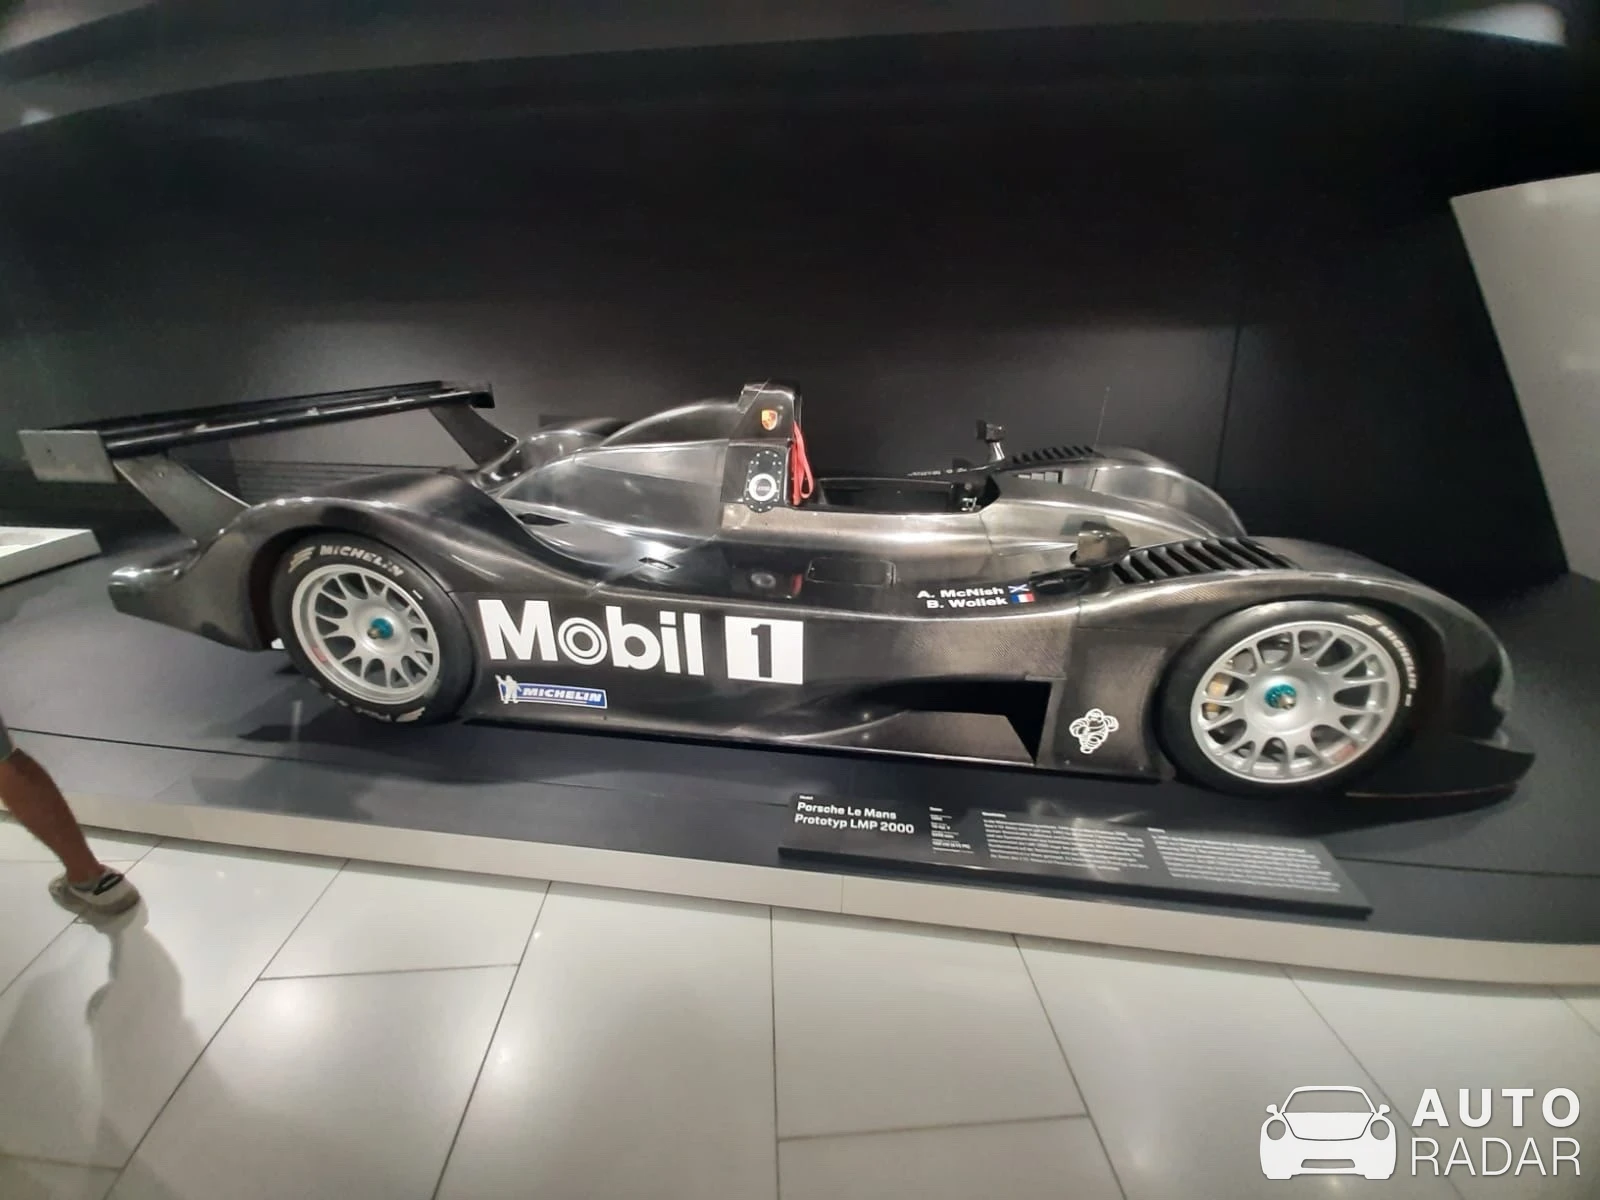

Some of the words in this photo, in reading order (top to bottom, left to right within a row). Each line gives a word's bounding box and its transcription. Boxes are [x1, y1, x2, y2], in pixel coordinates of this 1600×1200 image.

[917, 590, 935, 598] A.
[940, 587, 1004, 598] McNish
[926, 599, 944, 609] B.
[948, 597, 1008, 608] Wollek
[478, 599, 704, 676] Mobil
[522, 687, 602, 702] MICHELIN
[797, 801, 845, 815] Porsche
[847, 806, 862, 817] Le
[864, 807, 897, 820] Mans
[794, 813, 848, 829] Prototyp
[850, 819, 878, 830] LMP
[880, 821, 915, 834] 2000
